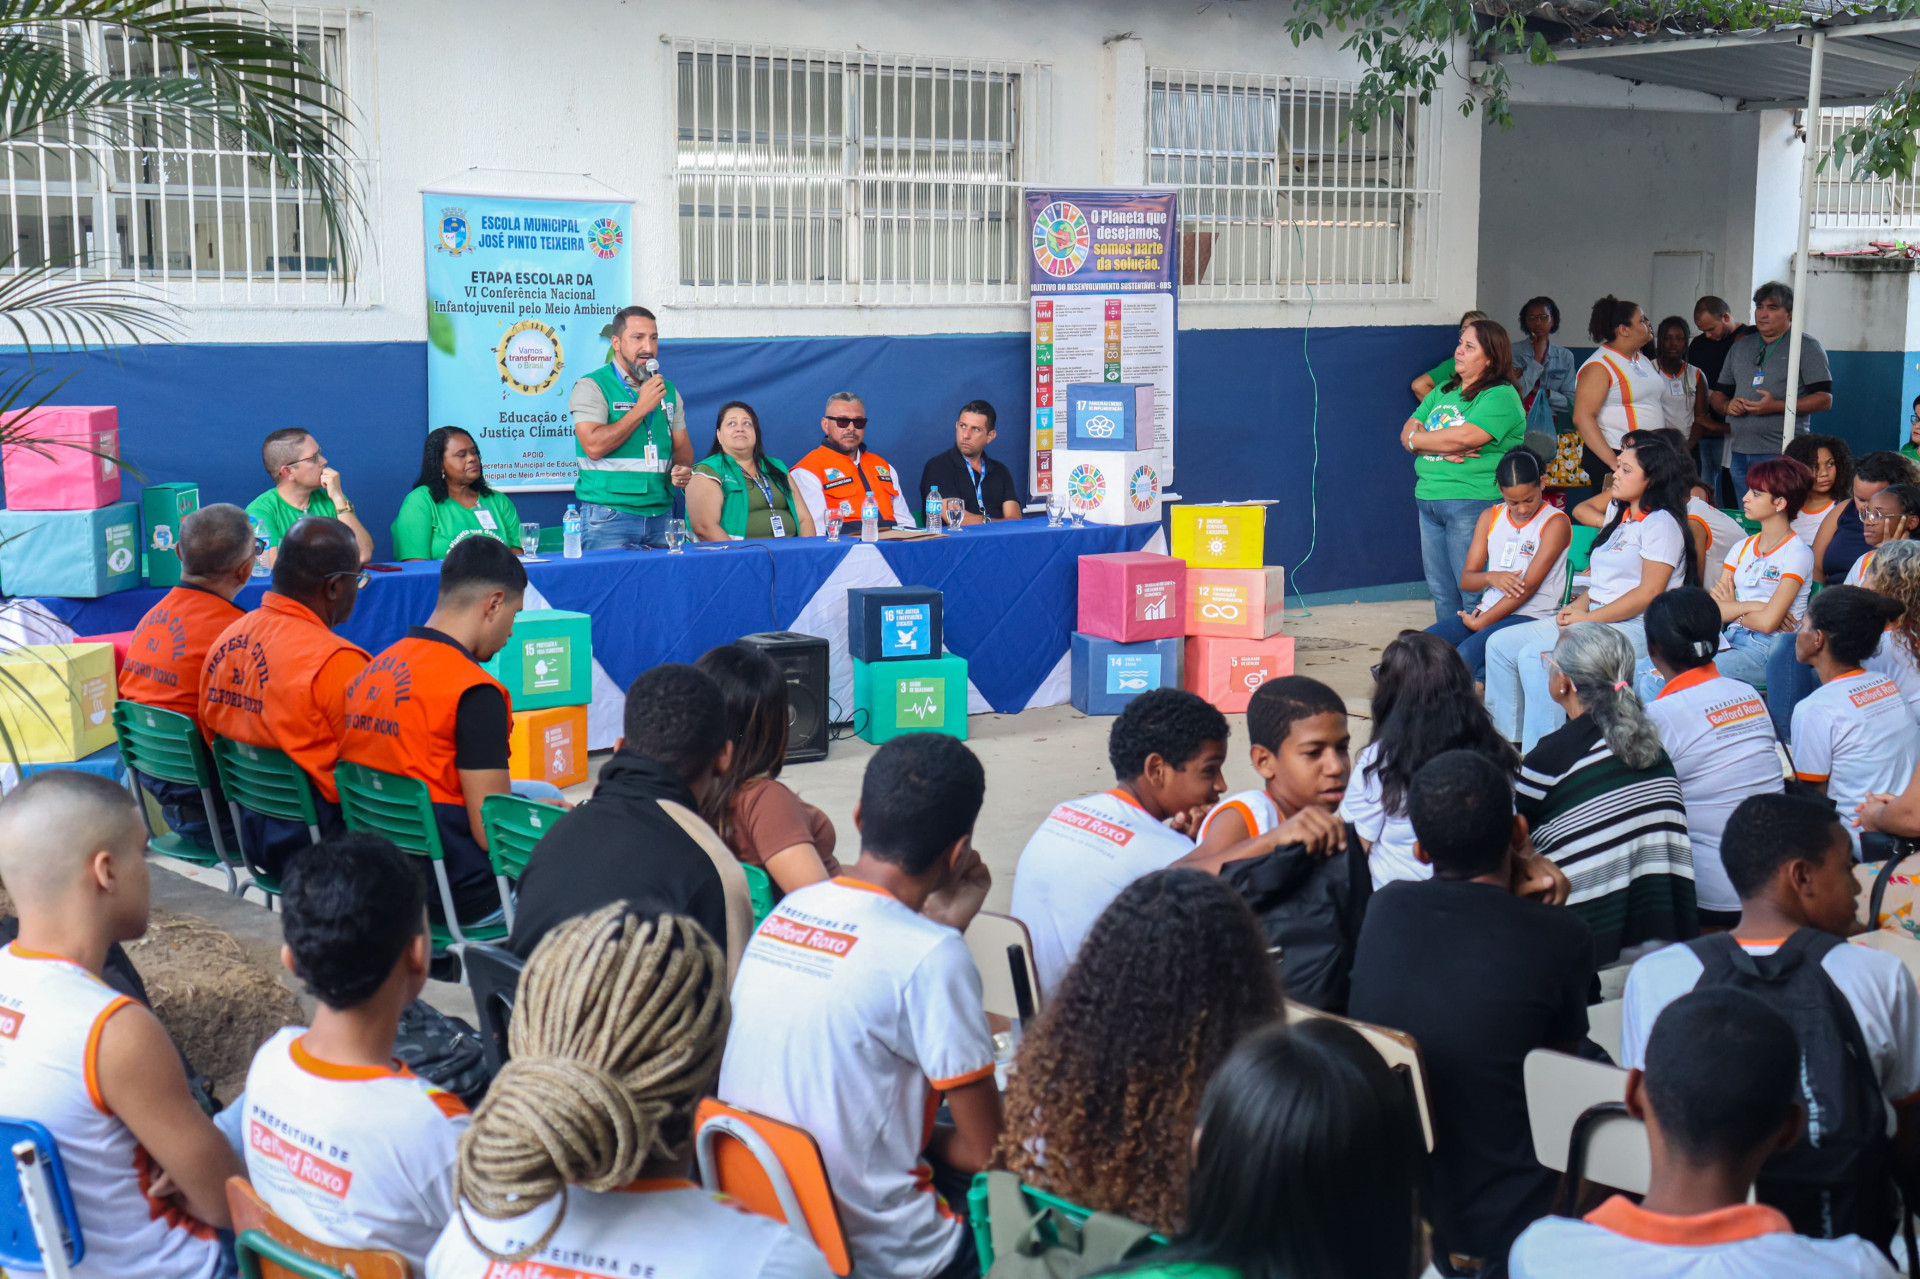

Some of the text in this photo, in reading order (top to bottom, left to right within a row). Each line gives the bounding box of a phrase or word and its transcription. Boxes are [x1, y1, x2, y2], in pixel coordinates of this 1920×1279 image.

[482, 216, 580, 234] ESCOLA MUNICIPAL
[1090, 210, 1167, 227] O Planeta que
[1096, 226, 1161, 240] desejamos,
[478, 232, 585, 252] JOSÉ PINTO TEIXEIRA
[1093, 242, 1163, 256] somos parte
[1096, 256, 1160, 272] da solução.
[471, 270, 593, 286] ETAPA ESCOLAR DA
[464, 286, 596, 300] VI Conferência Nacional
[1031, 283, 1056, 292] OBJETIVO
[1067, 283, 1119, 291] DESENVOLVIMENTO
[1120, 281, 1156, 290] SUSTENTÁVEL
[1160, 281, 1172, 290] ODS
[434, 300, 622, 316] Infantojuvenil pelo Meio Ambiente
[1076, 400, 1087, 411] 17
[499, 411, 568, 426] Educação e
[480, 426, 525, 440] Justiça
[1198, 519, 1203, 529] 7
[1198, 586, 1209, 596] 12
[884, 610, 894, 622] 16
[146, 637, 161, 652] RJ
[168, 616, 187, 661] CIVIL
[525, 643, 535, 656] 15
[251, 641, 269, 690] CIVIL
[1111, 657, 1122, 667] 14
[1231, 657, 1237, 667] 5
[152, 667, 178, 687] ROXO
[392, 662, 412, 708] CIVIL
[366, 686, 382, 700] RJ
[901, 682, 906, 693] 3
[1704, 696, 1747, 713] PREFEITURA
[1853, 688, 1883, 705] Belford
[1710, 703, 1763, 724] Belford Roxo
[374, 718, 399, 737] ROXO
[1088, 820, 1126, 842] Roxo
[780, 905, 858, 933] PREFEITURA DE
[762, 917, 848, 953] Belford Roxo
[253, 1104, 350, 1163] PREFEITURA DE
[300, 1156, 345, 1192] Roxo
[506, 1239, 655, 1279] PRFEITURA DE
